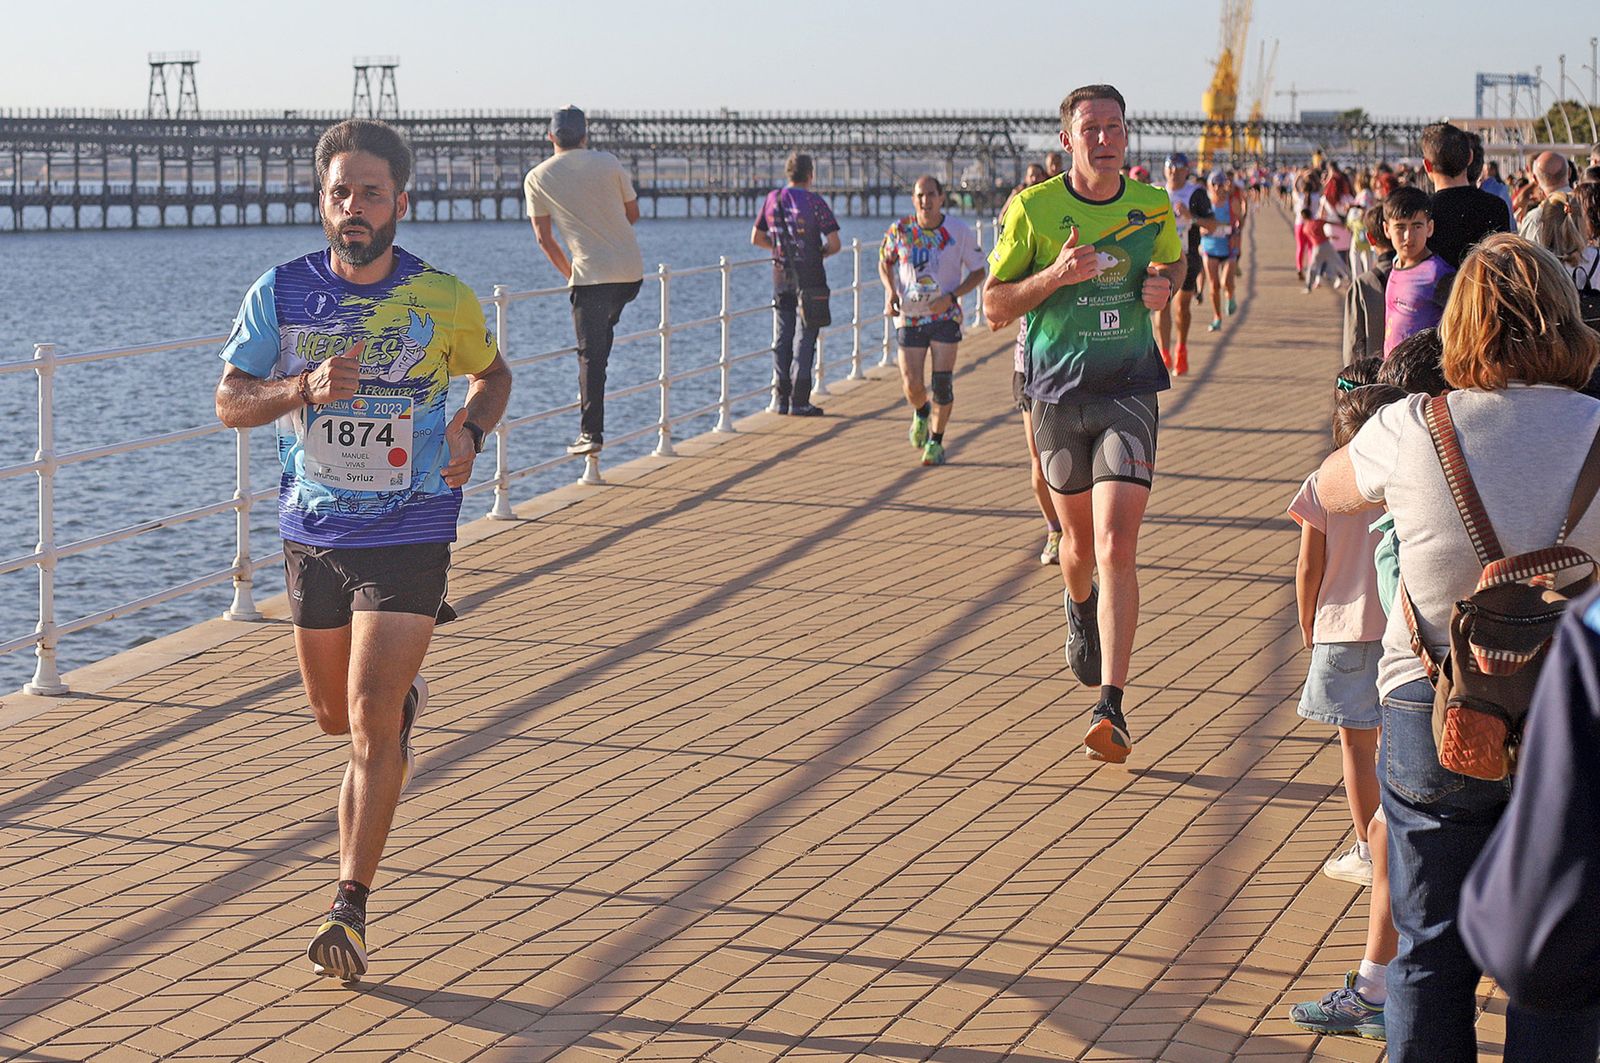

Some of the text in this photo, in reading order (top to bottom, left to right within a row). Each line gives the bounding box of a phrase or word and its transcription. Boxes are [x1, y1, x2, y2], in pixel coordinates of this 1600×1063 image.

[1091, 274, 1127, 284] CAMPING
[365, 385, 417, 397] FRONTERA
[374, 403, 402, 415] 2023
[322, 419, 395, 447] 1874
[341, 452, 370, 460] MANUEL
[346, 472, 374, 483] Syrluz
